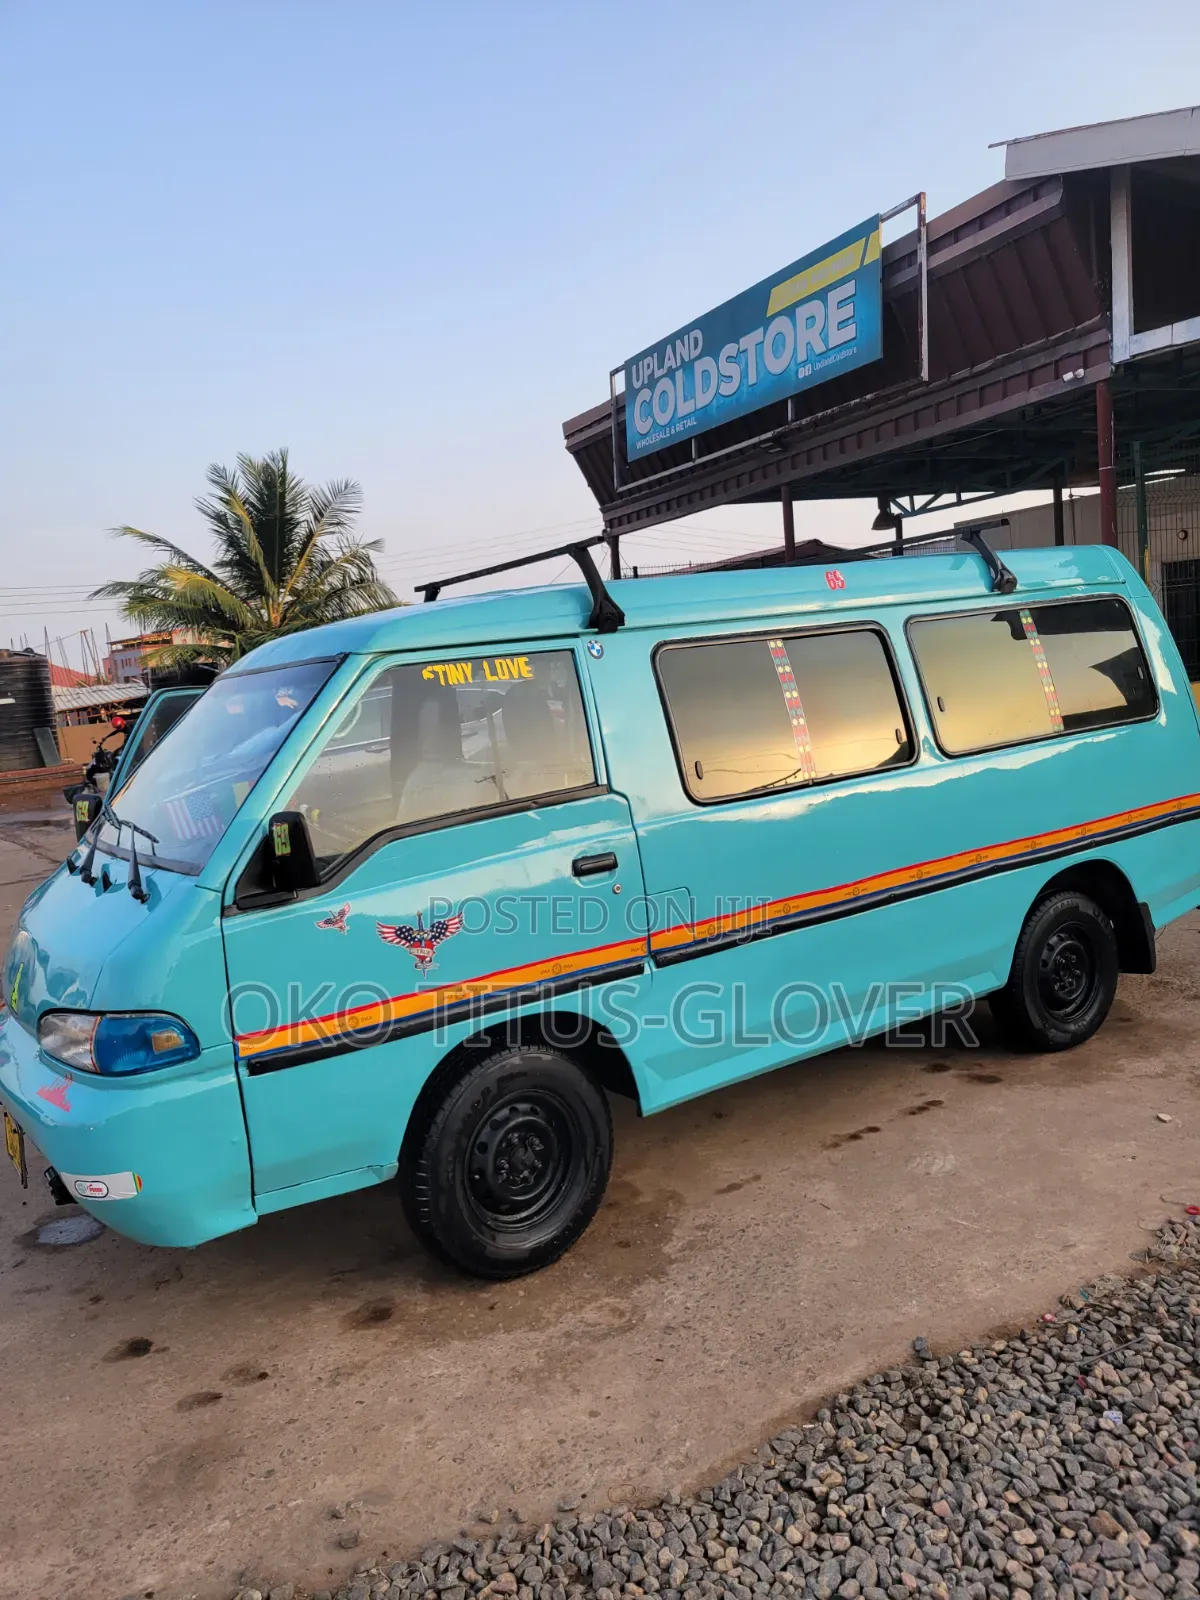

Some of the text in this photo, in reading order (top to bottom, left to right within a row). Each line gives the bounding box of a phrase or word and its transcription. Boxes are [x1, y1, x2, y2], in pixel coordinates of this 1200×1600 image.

[631, 329, 703, 389] UPLAND
[634, 279, 857, 435] COLDSTORE
[636, 416, 697, 450] WHOLESALE & RETAIL
[482, 656, 533, 682] LOVE
[273, 824, 291, 857] 69
